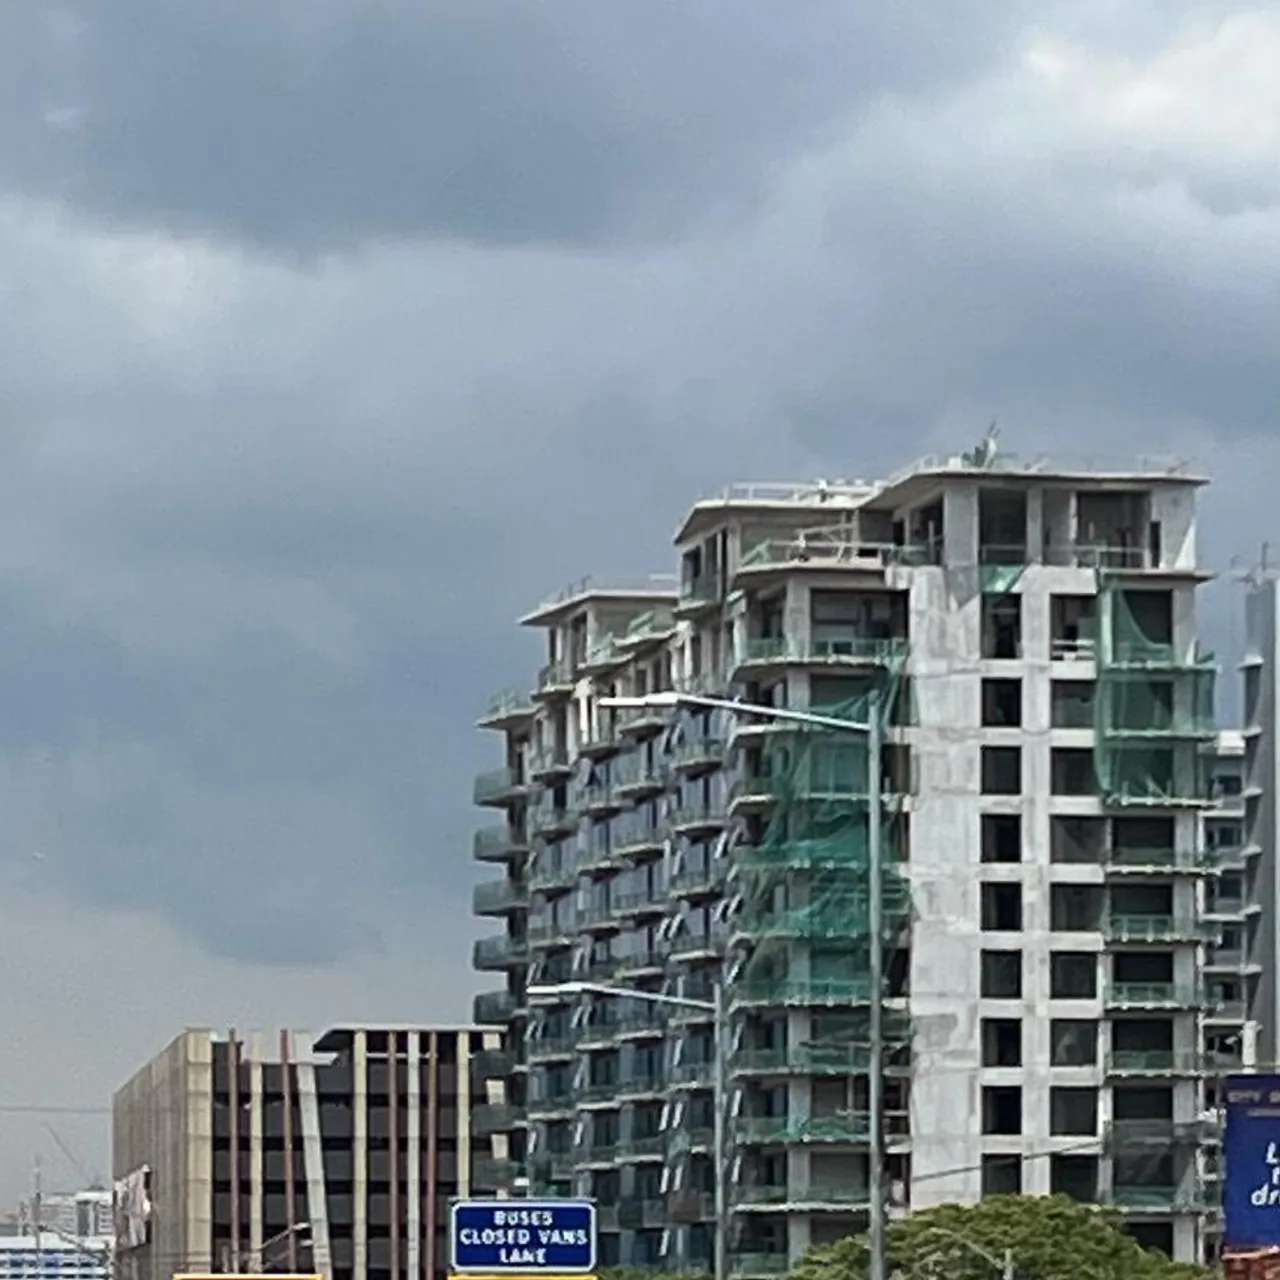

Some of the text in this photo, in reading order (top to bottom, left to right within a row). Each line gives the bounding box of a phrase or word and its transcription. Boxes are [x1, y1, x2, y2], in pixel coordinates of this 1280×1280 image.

[493, 1210, 554, 1226] BUSES
[459, 1228, 589, 1246] CLOSED VANS
[498, 1248, 548, 1264] LANE
